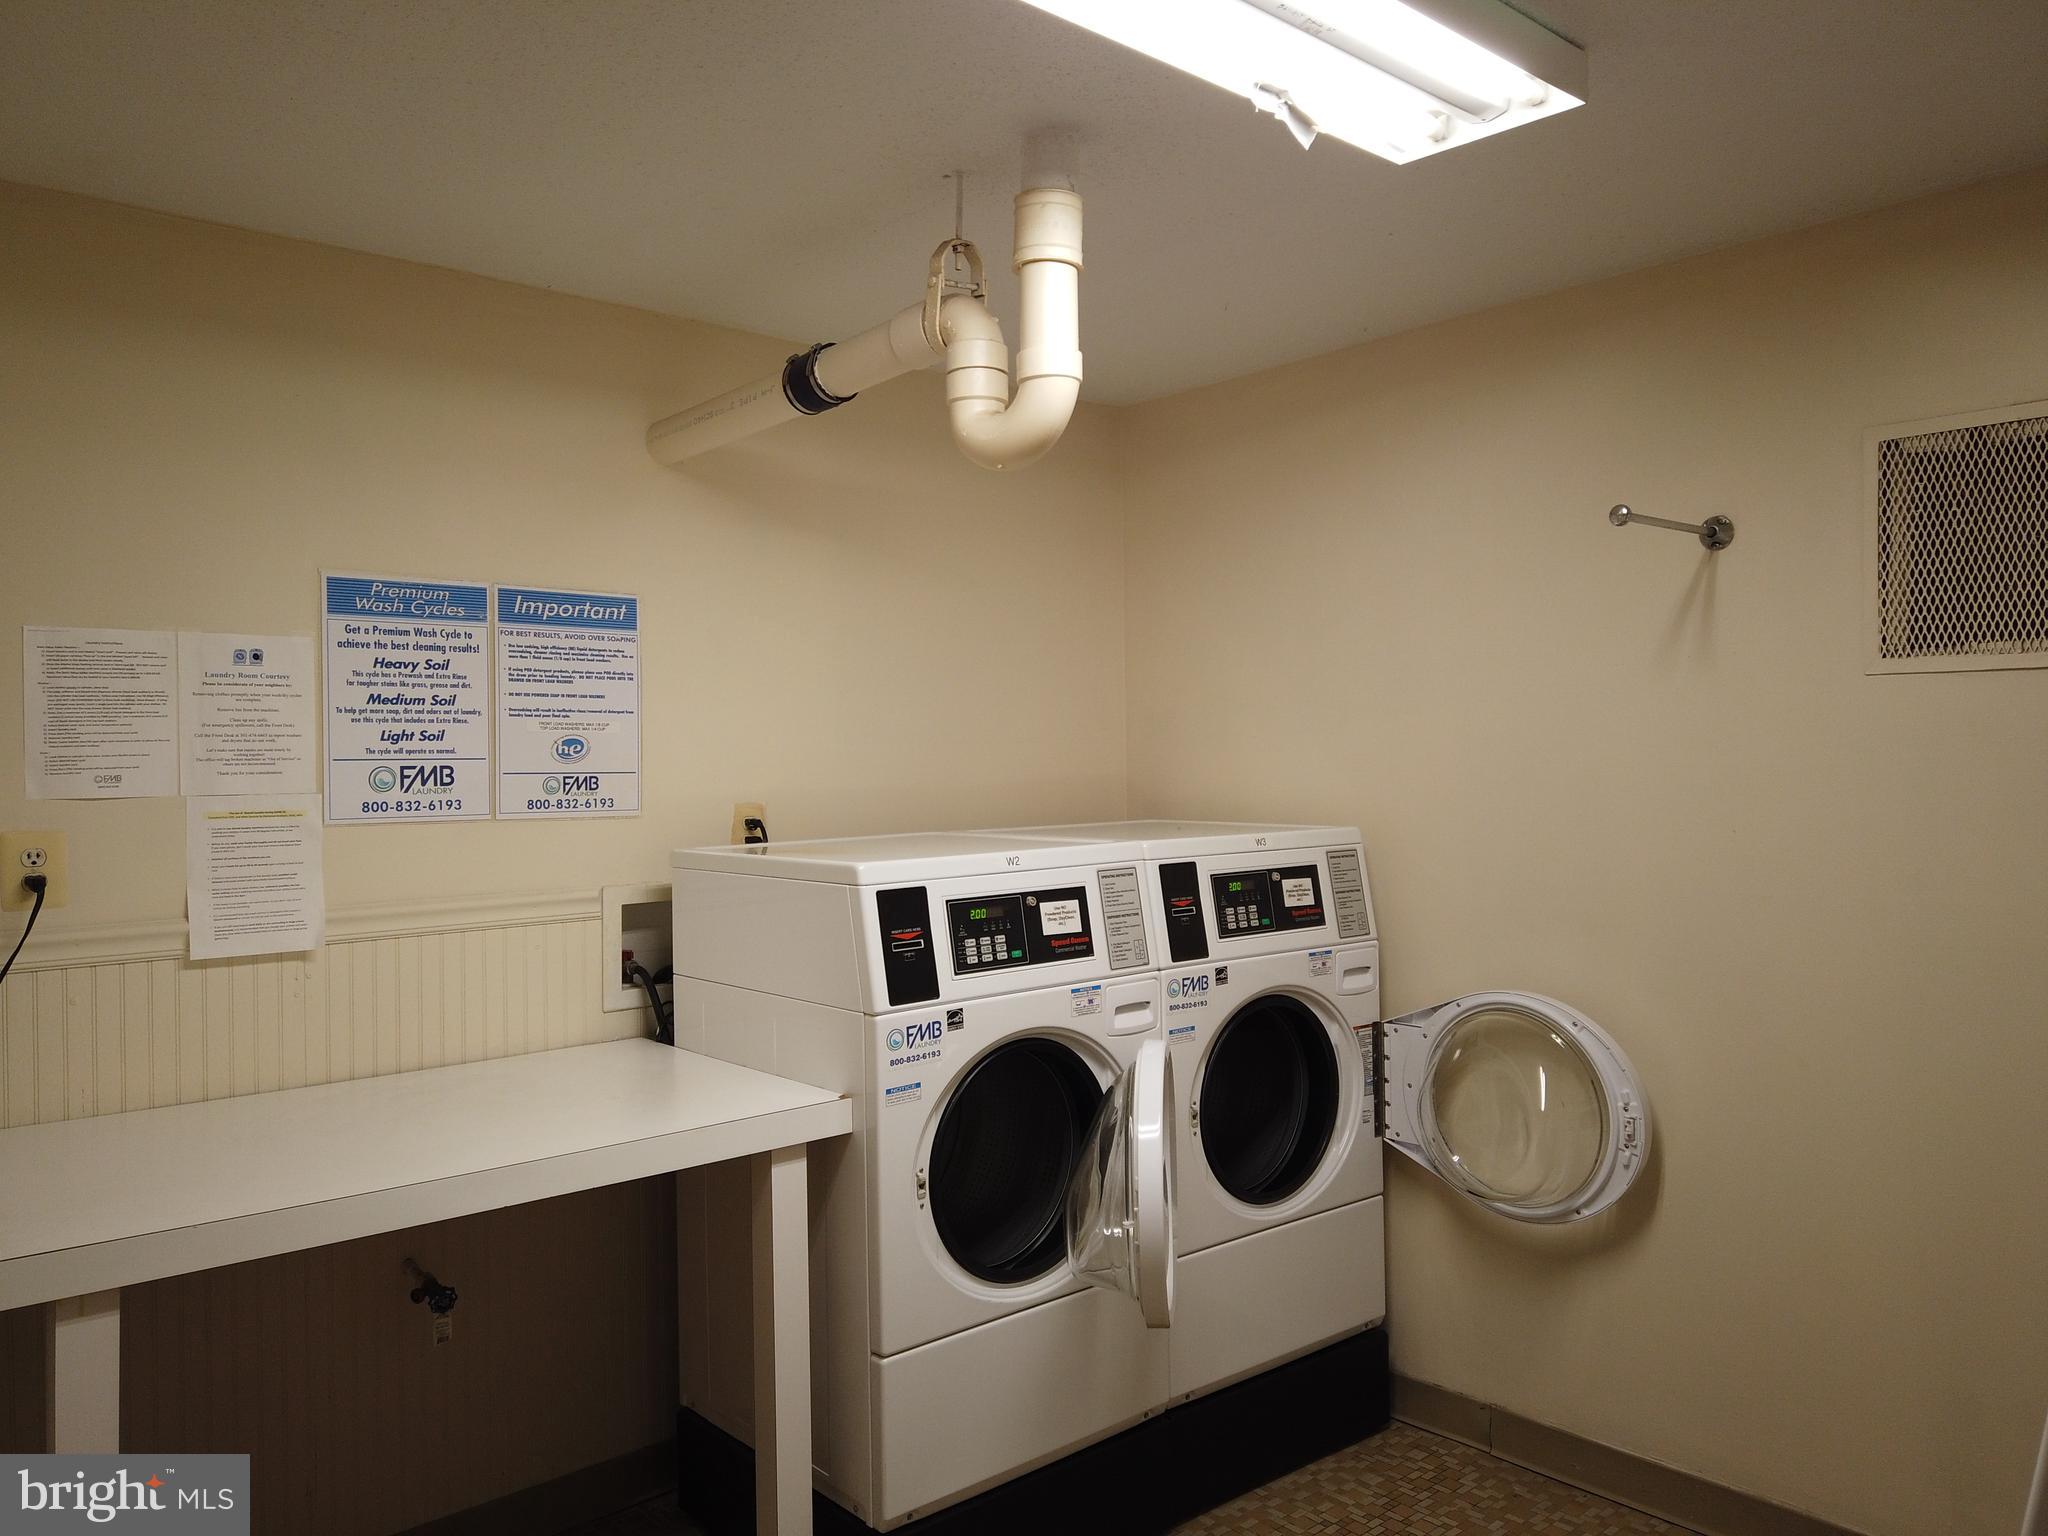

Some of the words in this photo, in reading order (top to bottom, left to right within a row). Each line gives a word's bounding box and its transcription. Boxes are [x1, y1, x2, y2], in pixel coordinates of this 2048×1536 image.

[370, 582, 449, 600] Premium
[356, 596, 403, 612] Wash
[411, 600, 465, 617] Cycles
[514, 595, 627, 620] Important
[344, 624, 360, 634] Get
[373, 626, 410, 637] Premium
[414, 628, 437, 638] Wash
[440, 629, 462, 641] Cycle
[464, 631, 472, 639] to
[534, 632, 562, 640] RESULTS,
[337, 639, 371, 649] achieve
[374, 640, 388, 650] the
[391, 641, 409, 651] best
[413, 642, 446, 654] cleaning
[449, 644, 480, 653] results!
[373, 657, 420, 672] Heavy
[424, 659, 450, 670] Soil
[357, 680, 378, 688] tougher
[366, 693, 426, 705] Medium
[430, 694, 456, 706] Soil
[344, 707, 356, 715] help
[380, 730, 415, 744] Light
[418, 730, 445, 742] Soil
[558, 740, 581, 756] he
[400, 765, 455, 793] FMB
[563, 776, 599, 796] FMB
[412, 787, 454, 795] LAUNDRY
[362, 800, 462, 813] 800-832-6193
[527, 798, 614, 810] 800-832-6193
[1254, 838, 1266, 846] W3
[1006, 856, 1021, 866] W2
[1182, 975, 1209, 997] FMB
[1169, 1000, 1207, 1011] 800-832-6193
[906, 1021, 942, 1049] FMB
[915, 1040, 941, 1049] LAUNDRY
[890, 1050, 941, 1066] 800-832-6193
[890, 1084, 916, 1093] NOTICE
